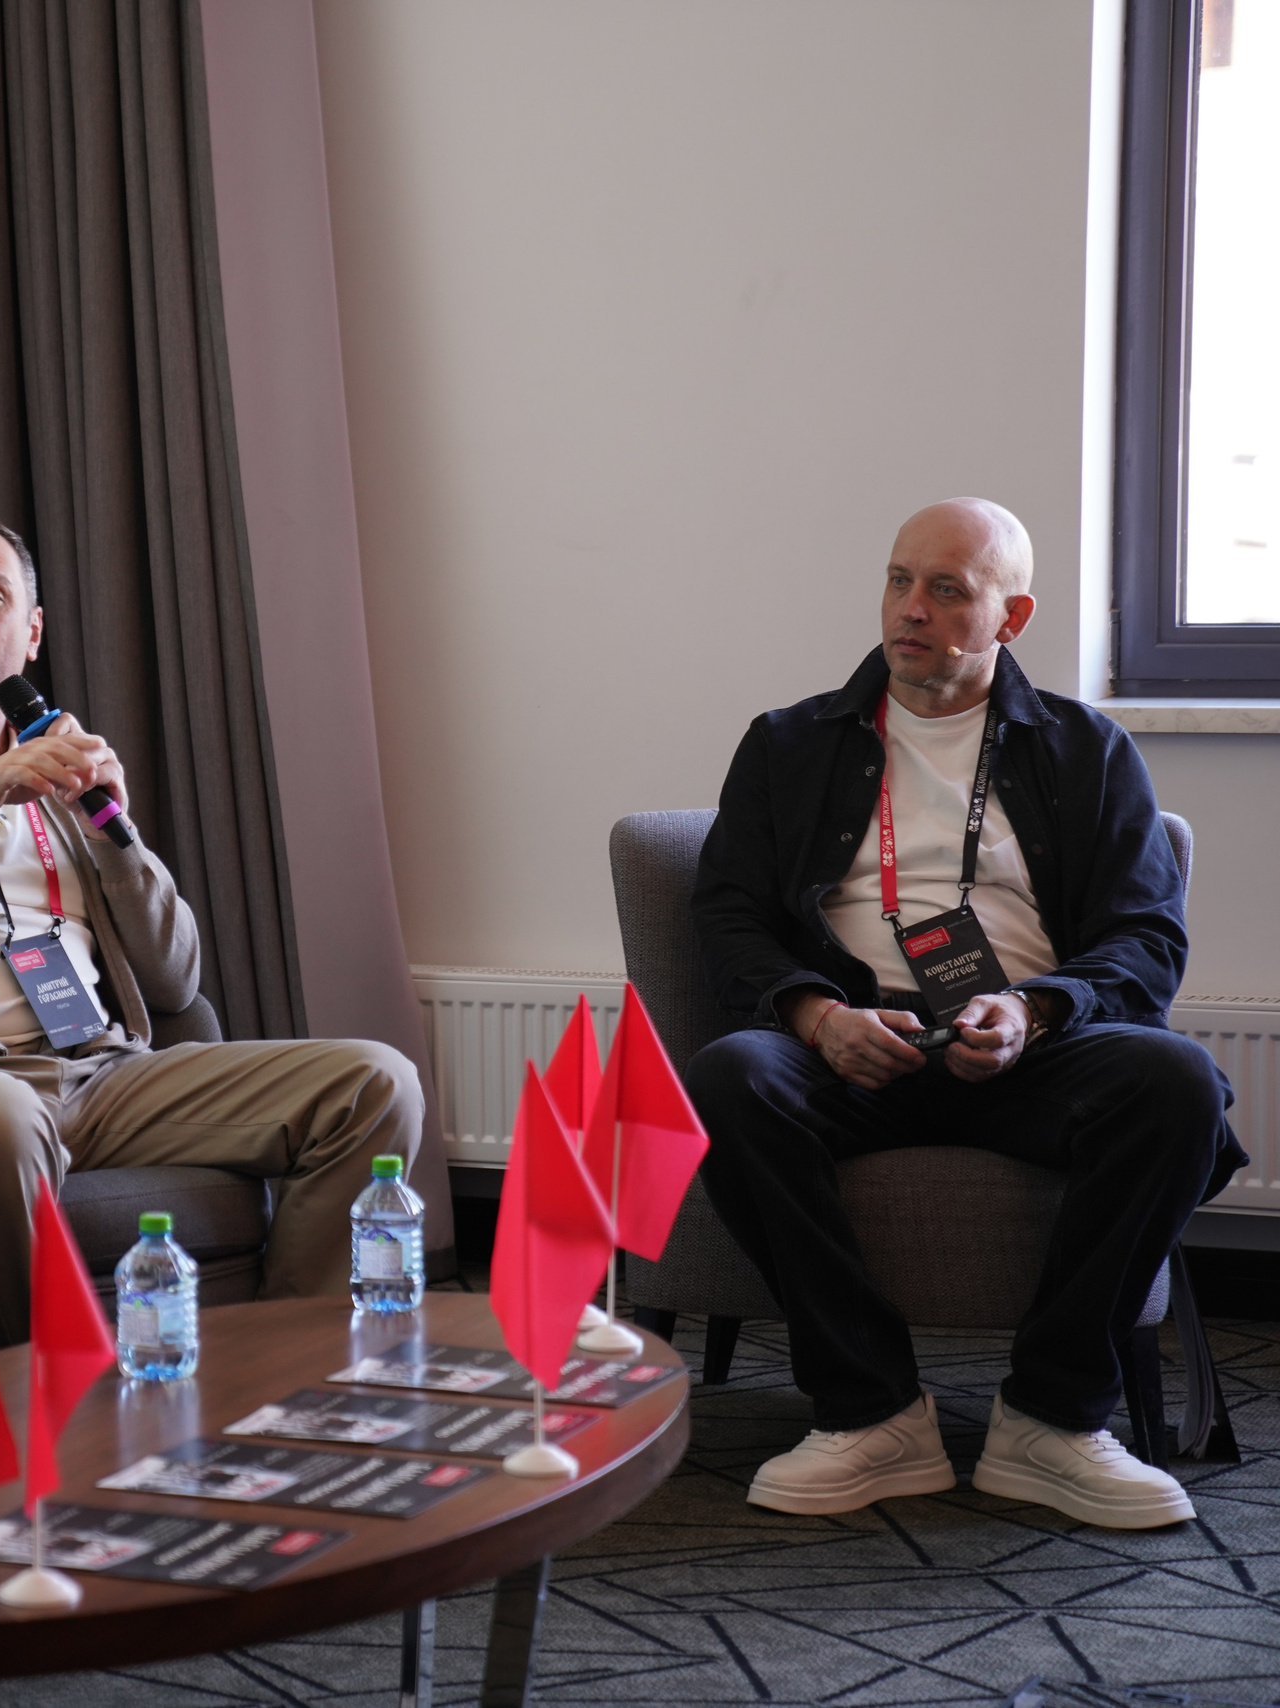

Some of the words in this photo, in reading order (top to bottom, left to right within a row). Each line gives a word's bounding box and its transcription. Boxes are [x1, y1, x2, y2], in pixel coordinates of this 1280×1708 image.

[924, 949, 983, 977] КОНСТАНТИН
[939, 962, 978, 983] СЕРГЕЕВ
[36, 976, 69, 995] ДМИТРИЙ
[37, 986, 77, 1005] ГЕРАСИМОВ
